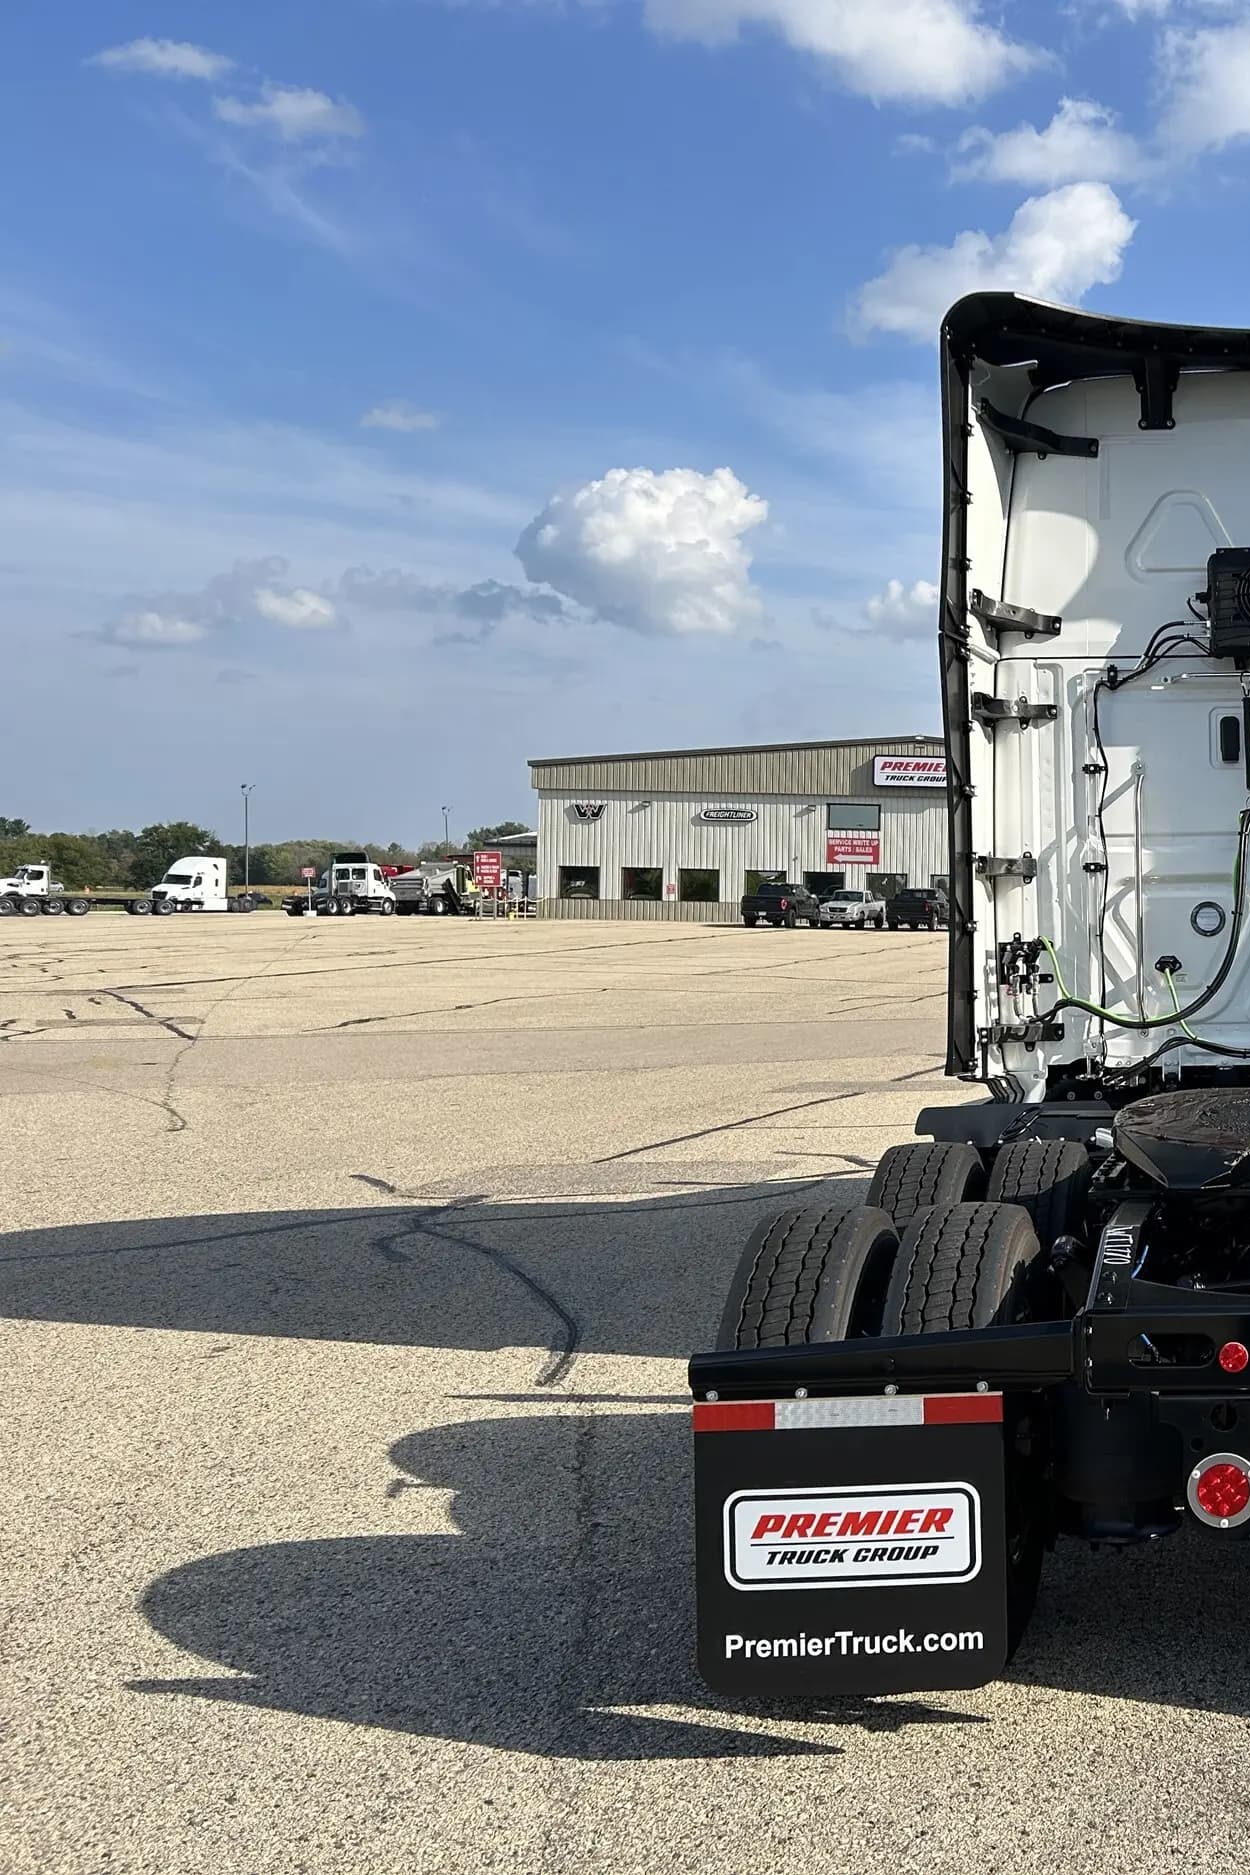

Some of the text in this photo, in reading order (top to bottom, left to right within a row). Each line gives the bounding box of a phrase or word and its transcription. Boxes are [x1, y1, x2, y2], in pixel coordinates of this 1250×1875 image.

[880, 761, 946, 772] PREMIE
[705, 811, 752, 819] FREIGHTLINER
[750, 1508, 954, 1540] PREMIER
[766, 1545, 940, 1566] TRUCK GROUP
[724, 1629, 984, 1659] PremierTruck.com
